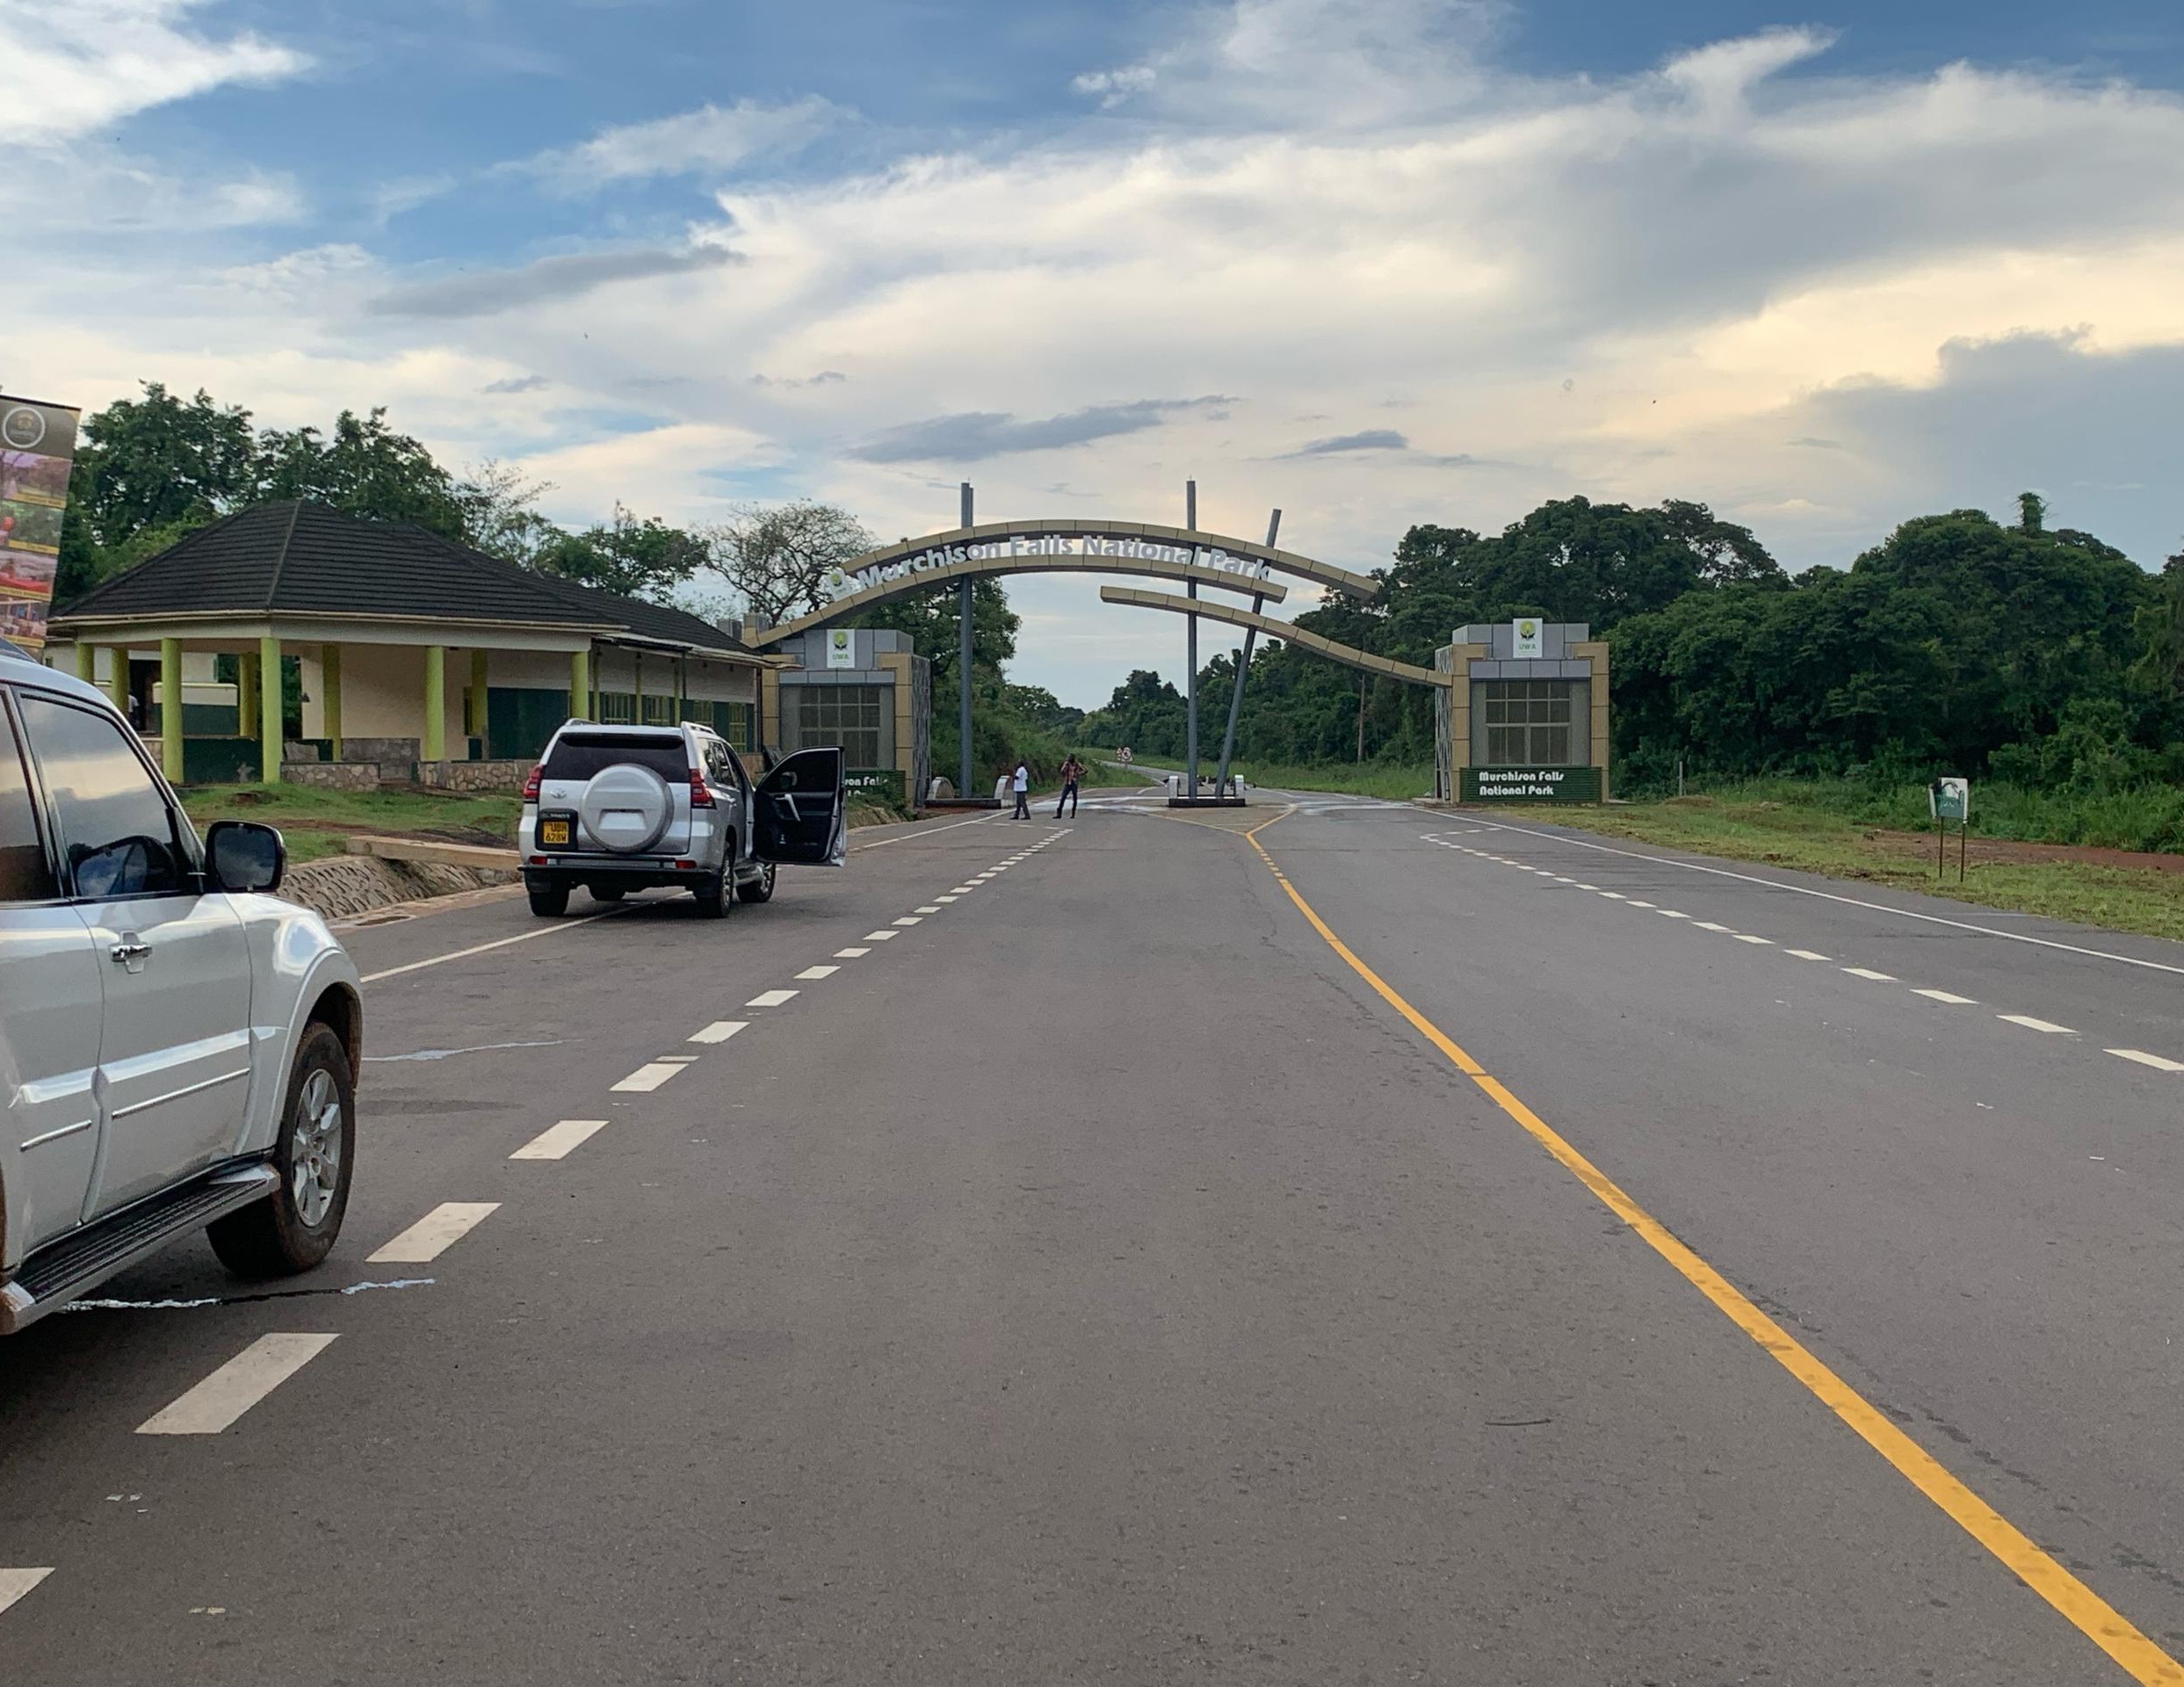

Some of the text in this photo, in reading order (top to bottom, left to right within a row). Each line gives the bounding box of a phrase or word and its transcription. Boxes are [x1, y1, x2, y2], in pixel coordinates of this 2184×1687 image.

[857, 534, 1271, 590] Murchison Falls National Park
[1479, 771, 1564, 781] Murchison Falls
[1479, 785, 1554, 795] National Park
